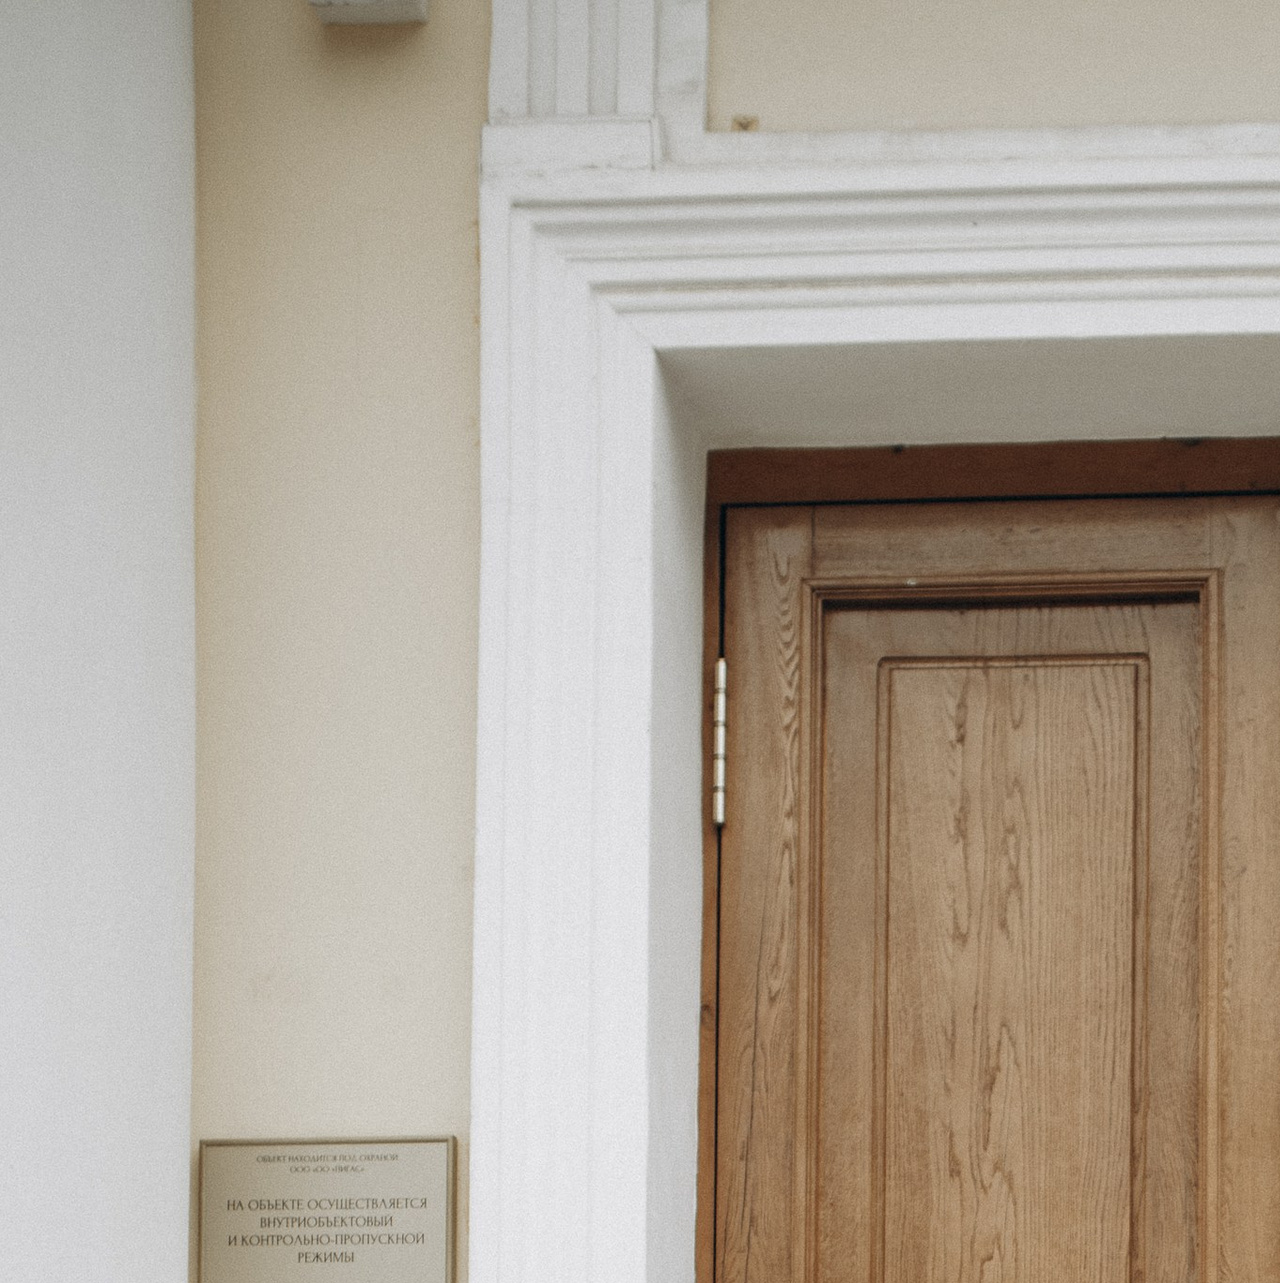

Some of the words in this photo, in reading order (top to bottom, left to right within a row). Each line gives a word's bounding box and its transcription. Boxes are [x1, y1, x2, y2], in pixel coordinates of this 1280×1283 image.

[227, 1199, 244, 1211] НА
[248, 1199, 305, 1211] ОБЪЕКТЕ
[307, 1198, 428, 1211] ОСУЩЕСТВЛЯЕТСЯ
[259, 1215, 393, 1228] ВНУТРИОБЪЕКТОВЫЙ
[228, 1235, 237, 1246] И
[241, 1232, 425, 1246] КОНТРОЛЬНО-ПРОПУСКНОЙ
[297, 1251, 355, 1263] РЕЖИМЫ
